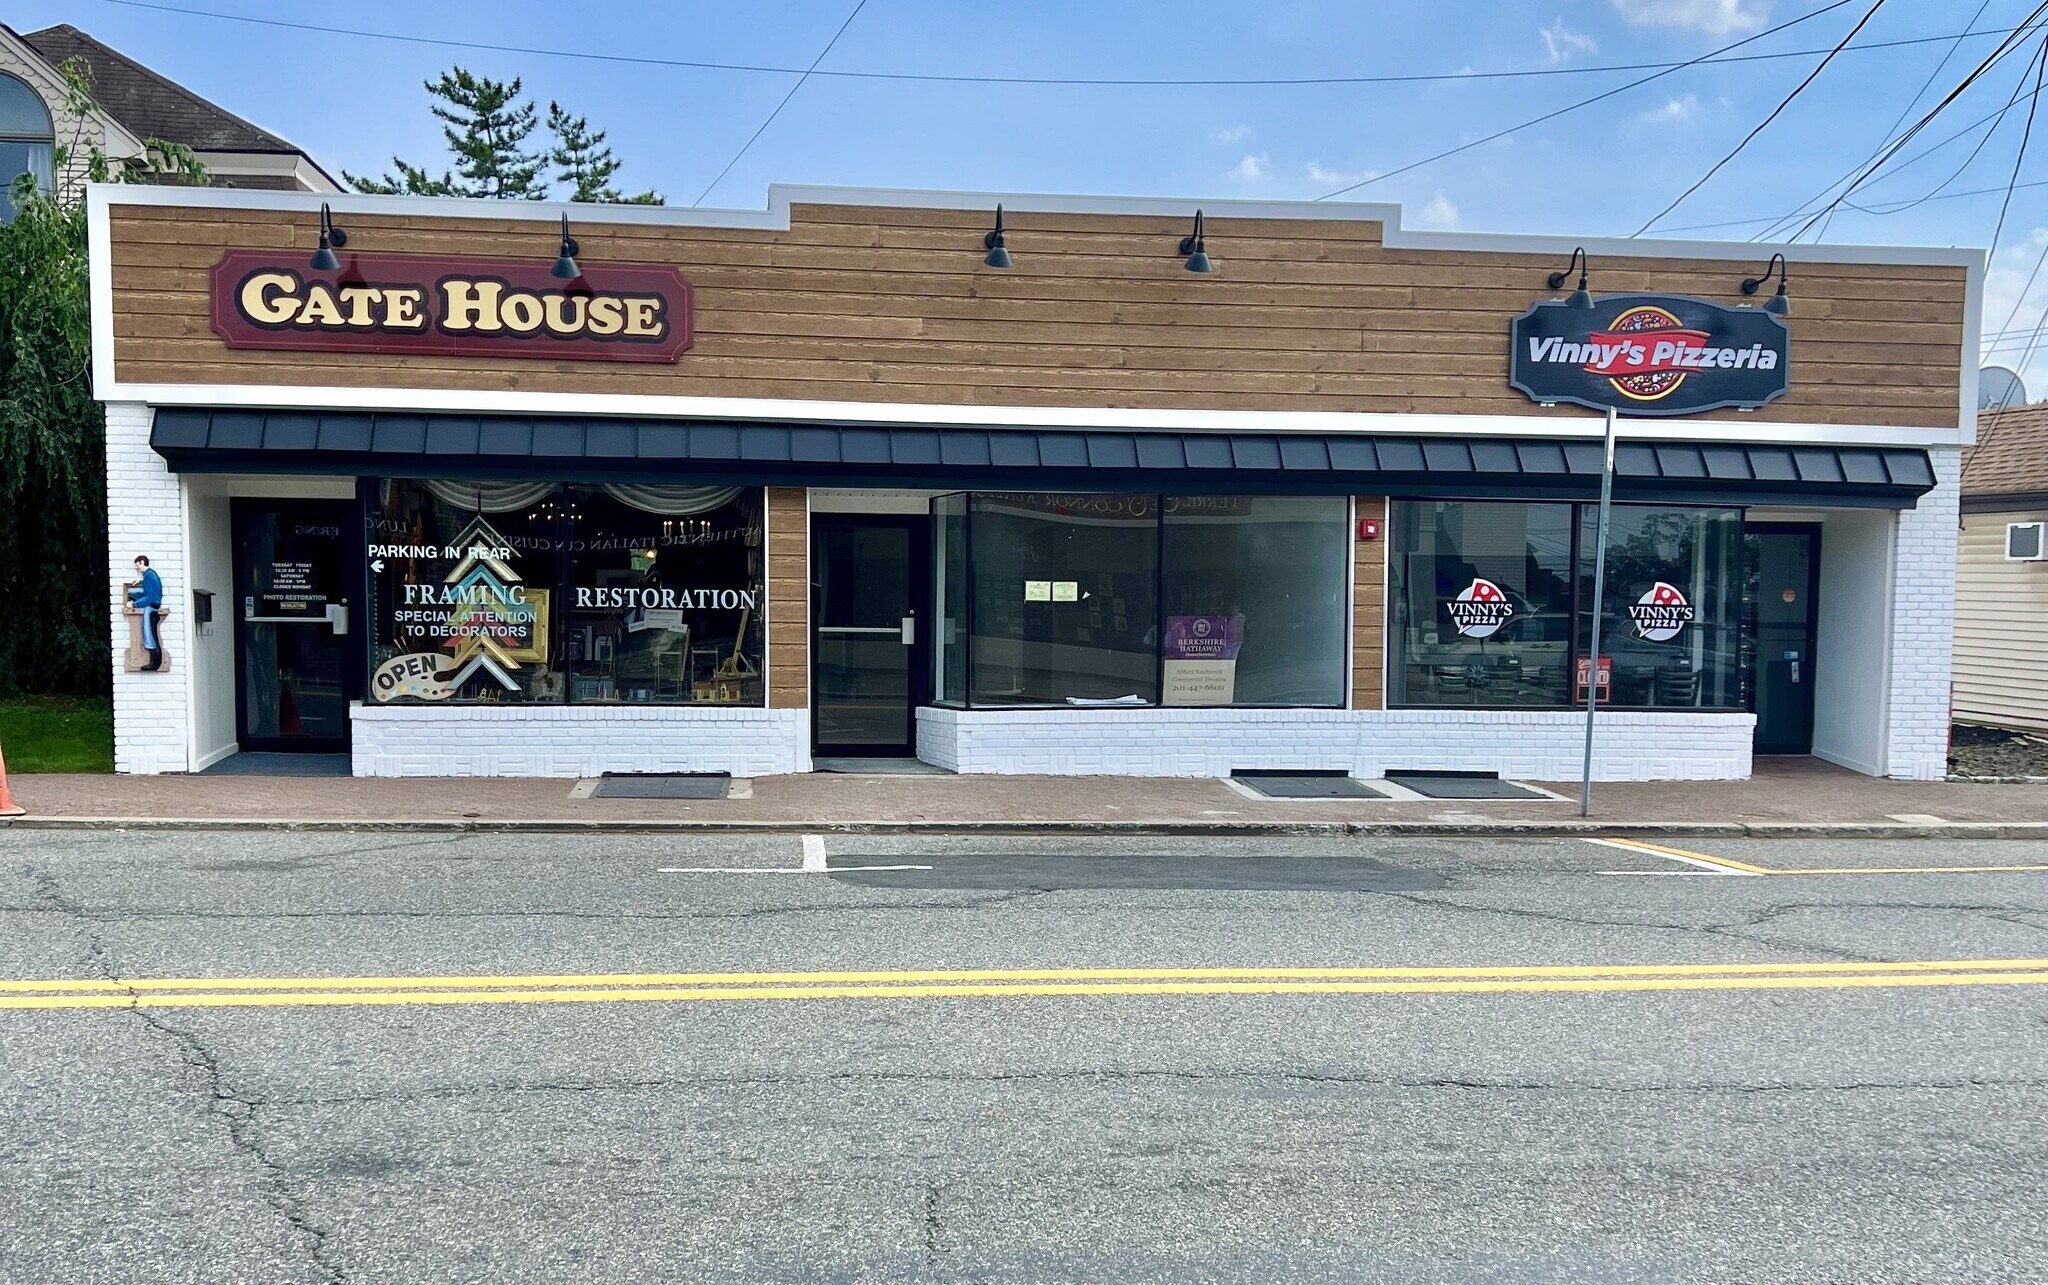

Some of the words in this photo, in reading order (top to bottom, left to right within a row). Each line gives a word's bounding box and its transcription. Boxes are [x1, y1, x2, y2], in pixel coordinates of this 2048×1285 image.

[241, 273, 424, 328] GATE
[441, 280, 663, 337] HOUSE
[1528, 336, 1645, 369] Vinny's
[1650, 341, 1778, 371] Pizzeria
[368, 544, 438, 558] PARKING
[444, 546, 460, 559] IN
[468, 546, 511, 560] REAR
[404, 584, 527, 606] FRAMING
[576, 587, 756, 610] RESTORATION
[394, 610, 454, 622] SPECIAL
[459, 611, 538, 623] ATTENTION
[1447, 602, 1513, 616] VINNY'S
[1628, 605, 1694, 620] VINNY'S
[1462, 615, 1496, 624] PIZZA
[1643, 619, 1677, 628] PIZZA
[406, 625, 425, 637] TO
[430, 626, 527, 638] DECORATORS
[1178, 638, 1225, 646] BERKSHIRE
[377, 654, 438, 690] OPEN
